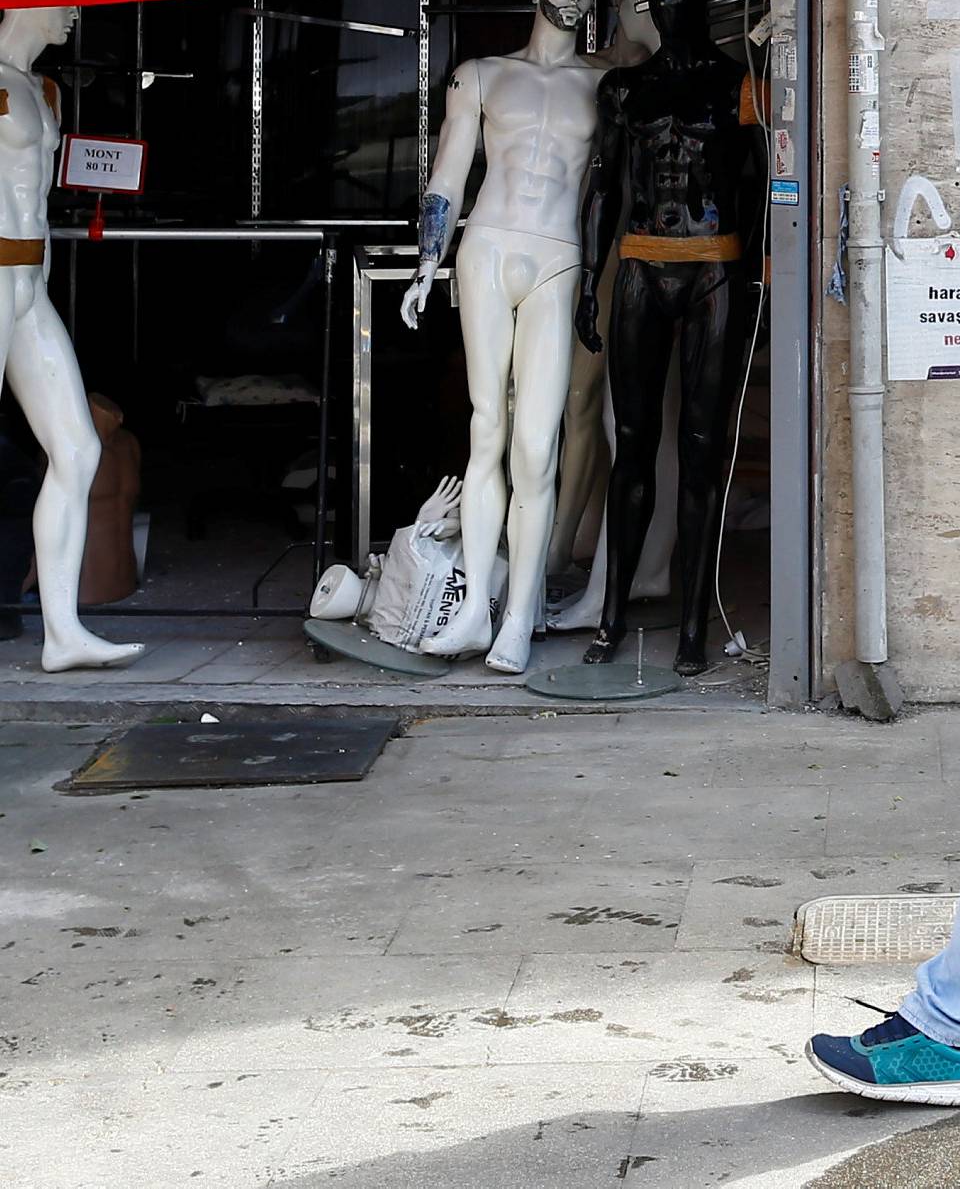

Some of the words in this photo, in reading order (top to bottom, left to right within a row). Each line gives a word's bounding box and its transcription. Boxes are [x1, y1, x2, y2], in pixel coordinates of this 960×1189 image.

[84, 148, 123, 160] MONT
[86, 161, 99, 171] 80
[101, 162, 118, 173] TL
